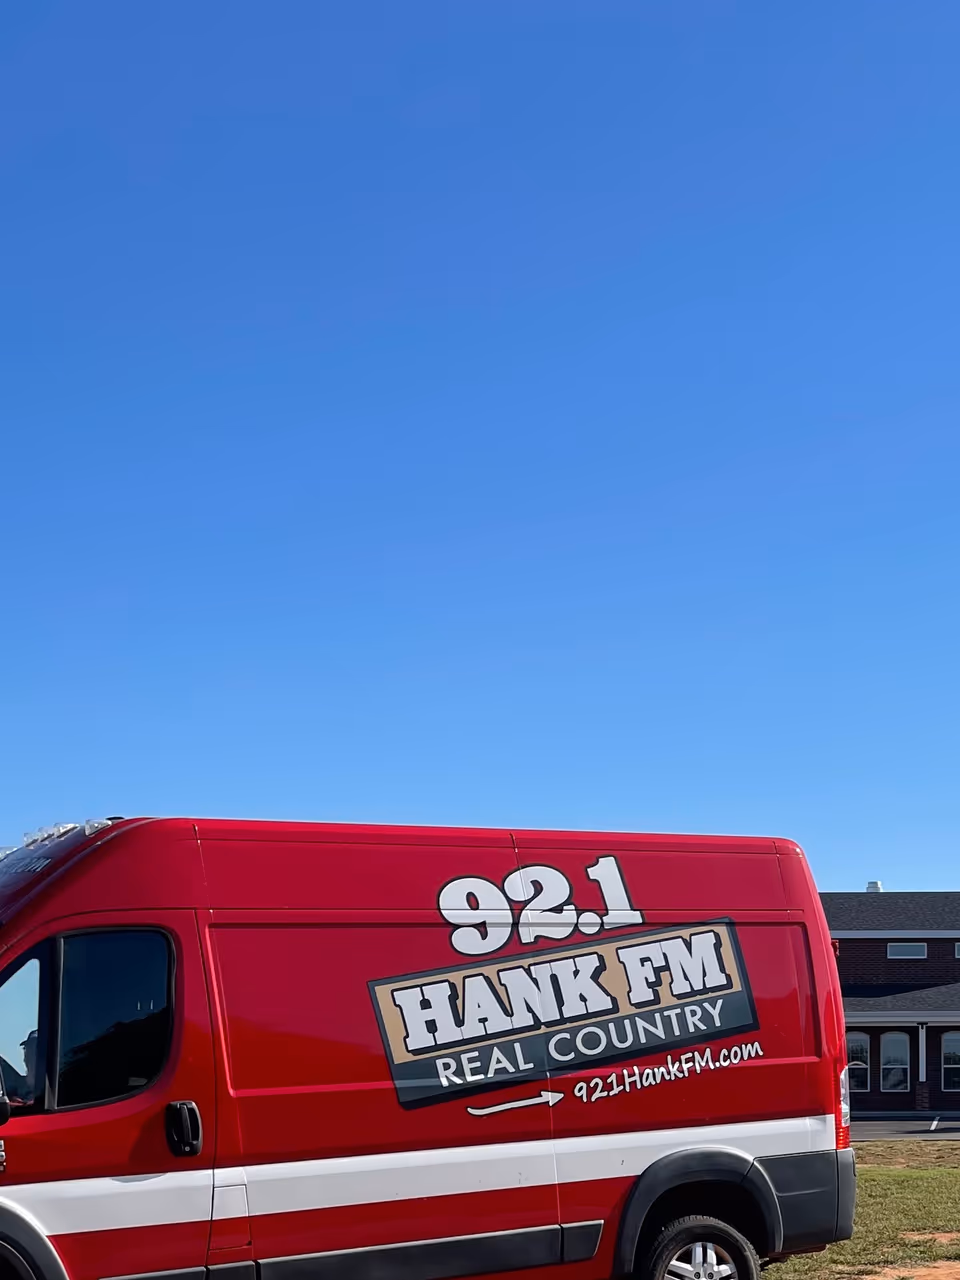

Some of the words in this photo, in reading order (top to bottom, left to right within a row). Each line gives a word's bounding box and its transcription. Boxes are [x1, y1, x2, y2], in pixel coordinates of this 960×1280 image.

[439, 855, 643, 955] 92.1
[392, 953, 619, 1054] HANK
[617, 931, 732, 1007] FM
[435, 1042, 534, 1088] REAL
[548, 1000, 725, 1062] COUNTRY
[573, 1040, 764, 1103] 921HankFM.com
